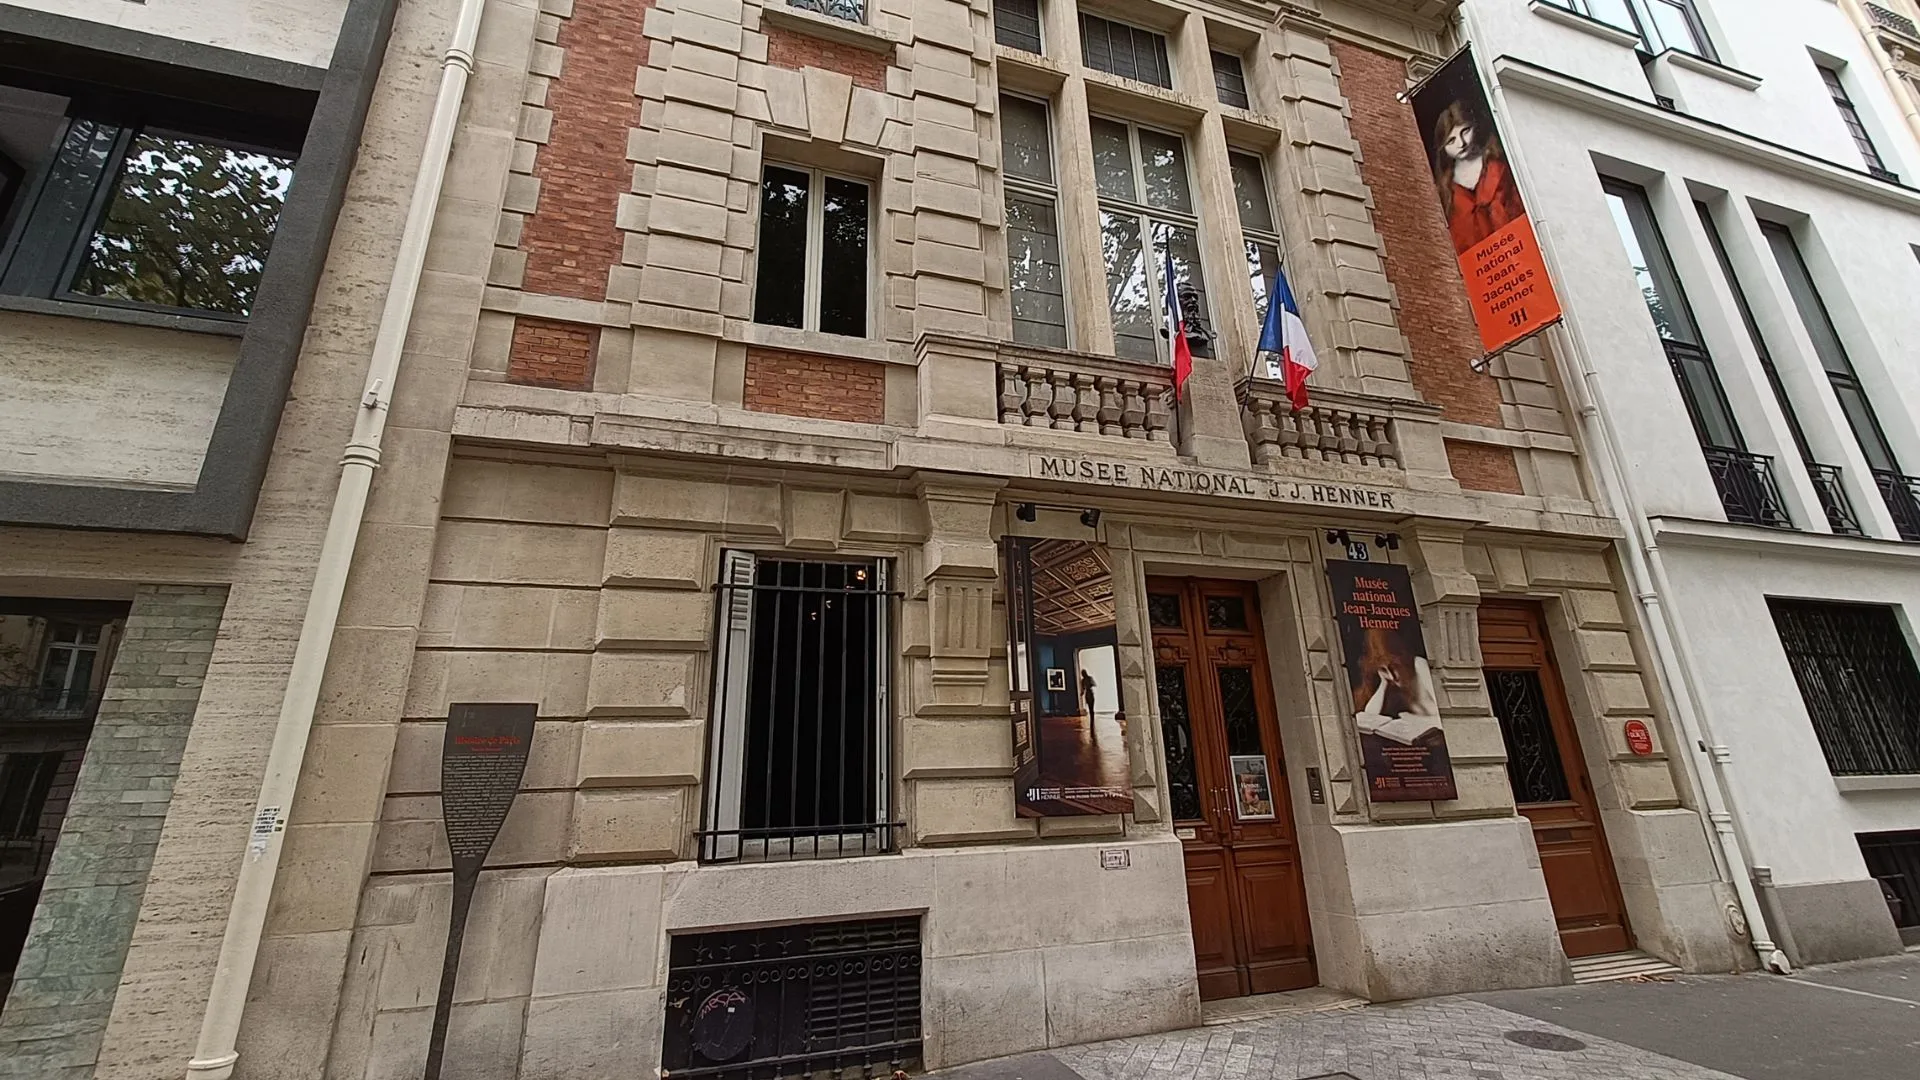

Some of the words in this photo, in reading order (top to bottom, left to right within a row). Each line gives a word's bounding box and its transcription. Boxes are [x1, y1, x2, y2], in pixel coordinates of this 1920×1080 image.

[1476, 233, 1515, 262] Musée
[1476, 240, 1524, 277] national
[1482, 269, 1534, 303] Jacques
[1486, 262, 1520, 286] Jean-
[1490, 283, 1535, 314] Henner
[1040, 457, 1128, 482] MUSEE
[1140, 467, 1255, 494] NATIONAL
[1311, 485, 1395, 509] HENNER
[1348, 542, 1367, 560] 43
[1354, 576, 1389, 590] Musée
[1352, 590, 1396, 603] national
[1343, 601, 1411, 618] Jean-Jacques
[1359, 615, 1400, 629] Henner
